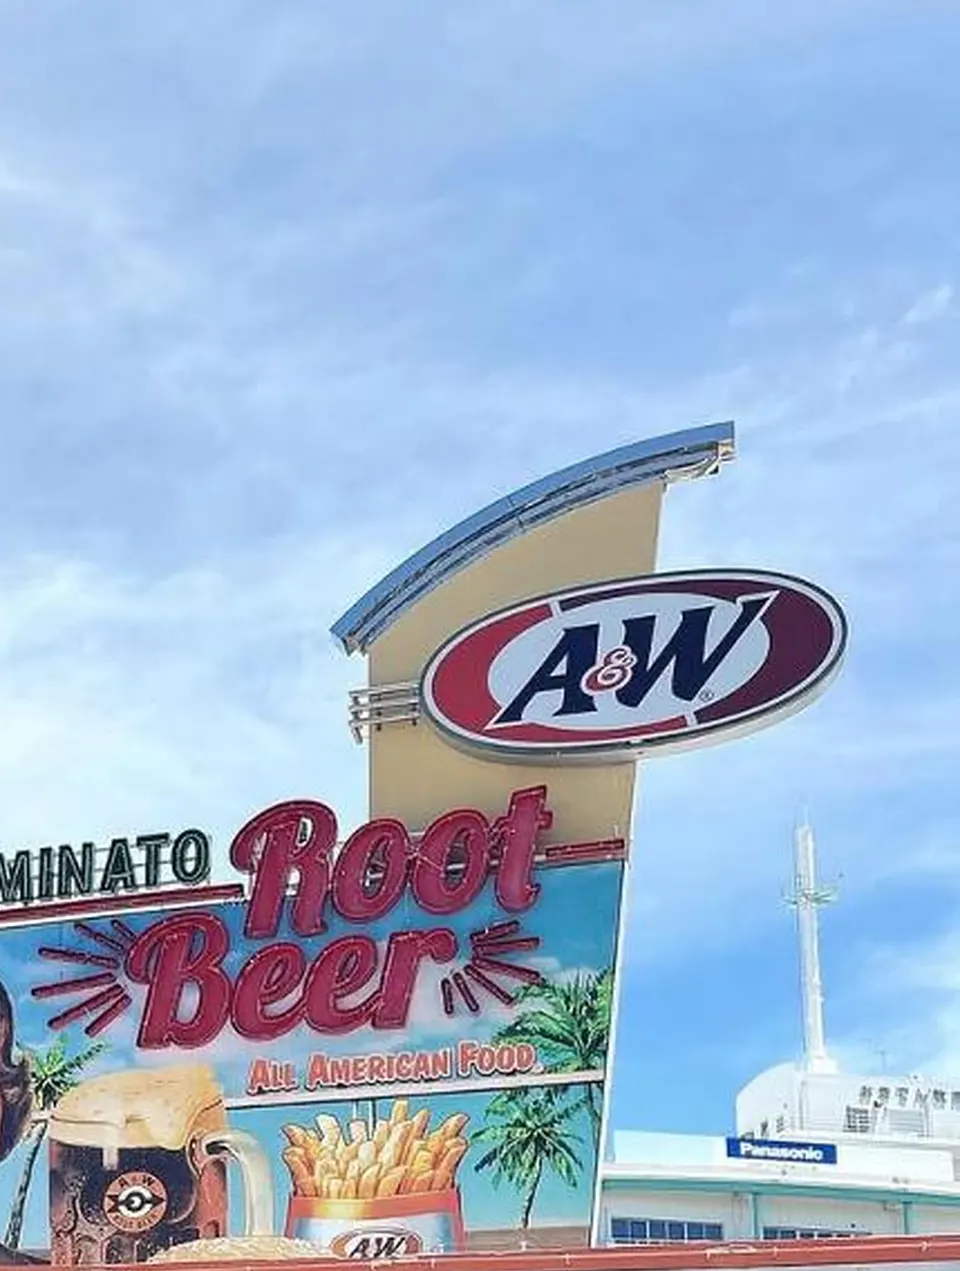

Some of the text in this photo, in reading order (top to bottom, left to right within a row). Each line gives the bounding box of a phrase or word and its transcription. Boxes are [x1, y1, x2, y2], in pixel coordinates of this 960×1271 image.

[487, 591, 778, 728] A&W
[230, 786, 553, 939] Root
[123, 910, 457, 1048] Beer
[740, 1141, 823, 1160] Panasonic
